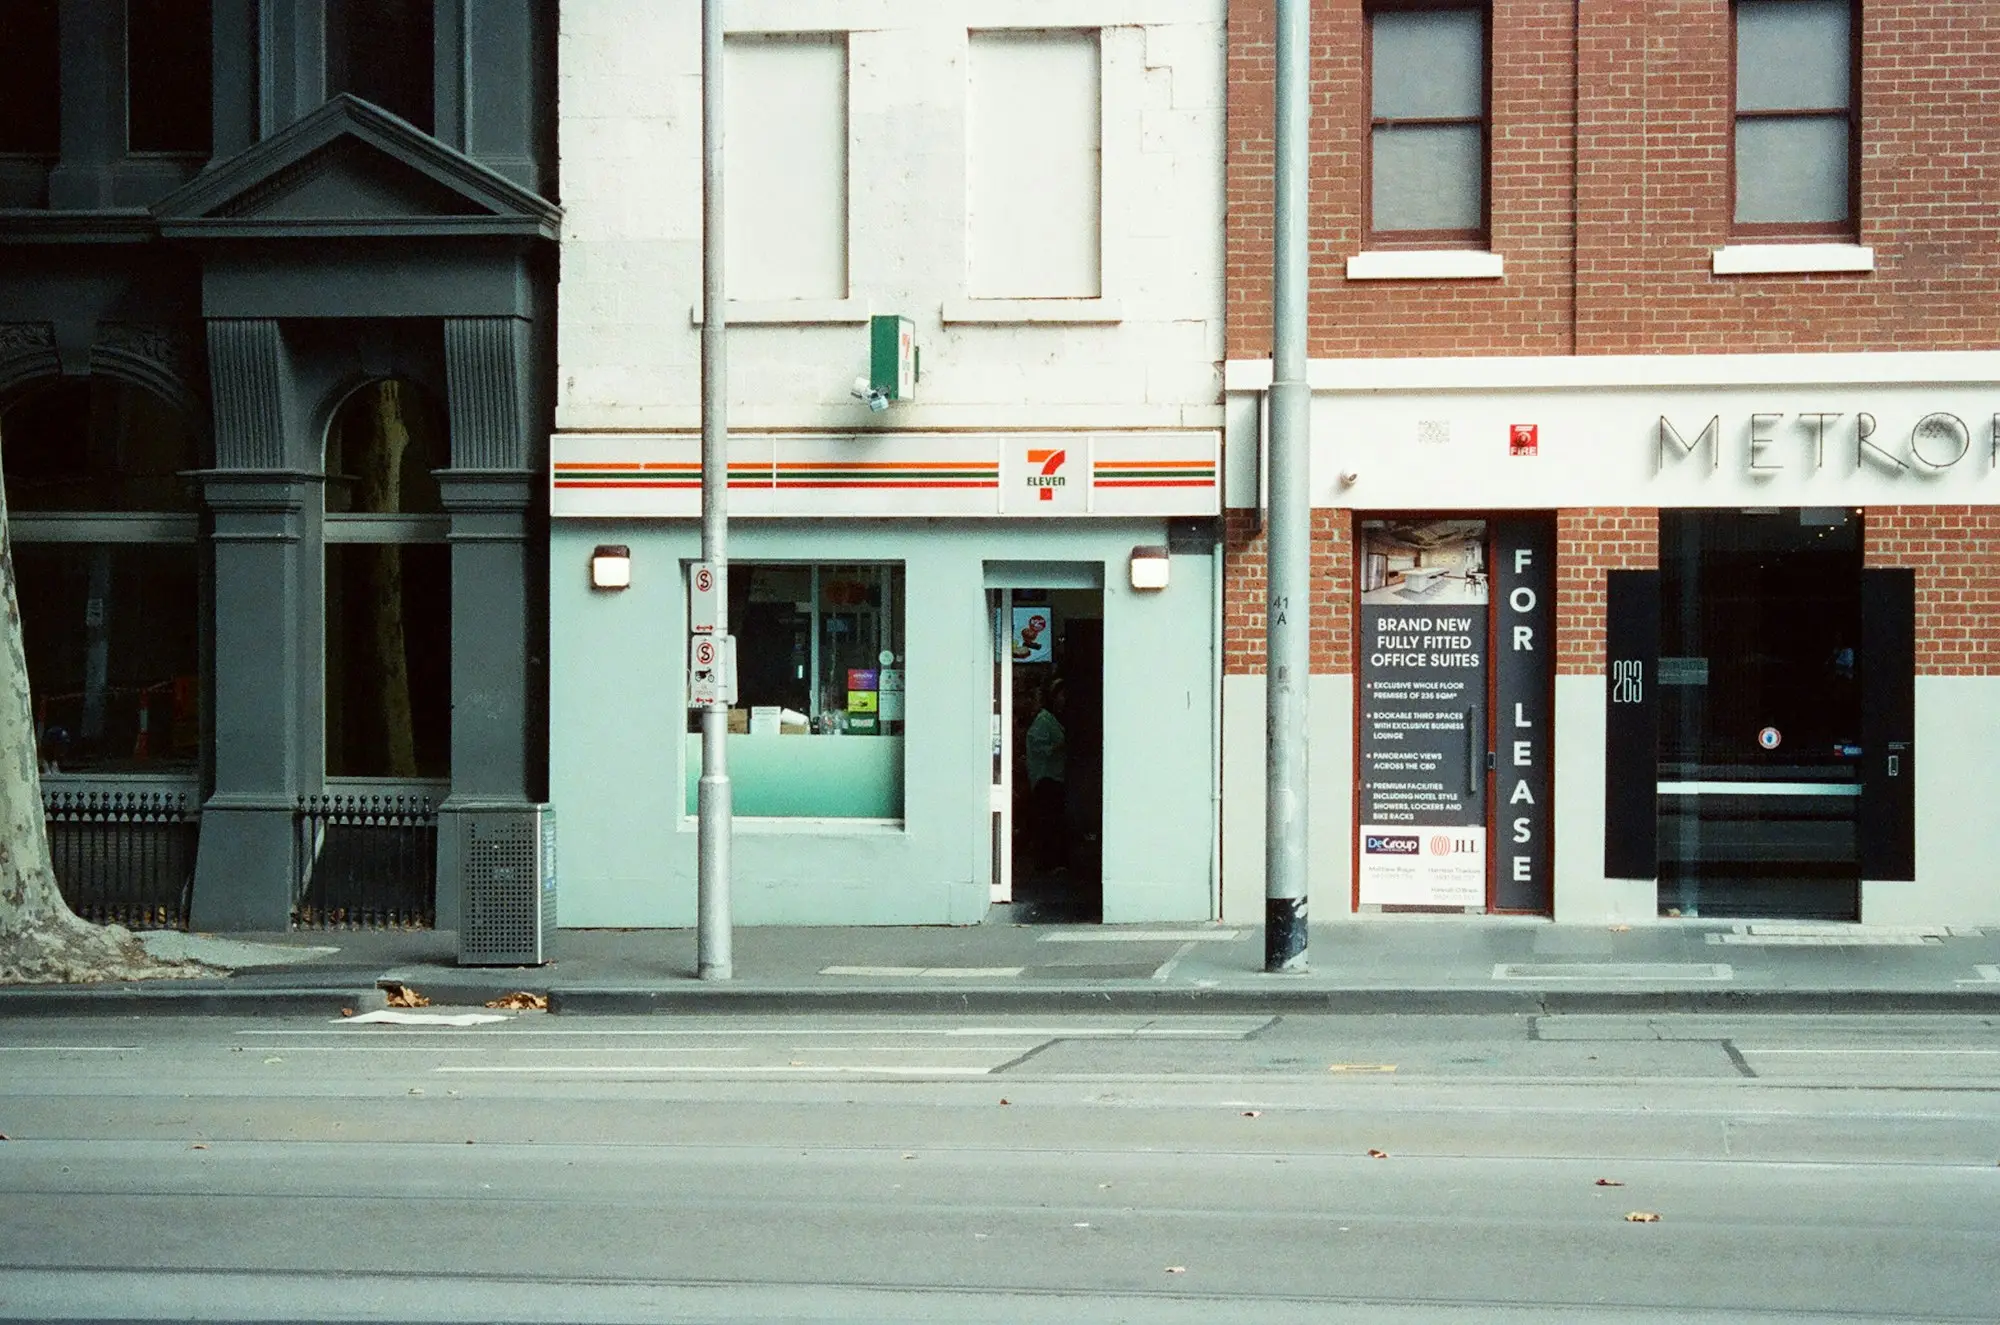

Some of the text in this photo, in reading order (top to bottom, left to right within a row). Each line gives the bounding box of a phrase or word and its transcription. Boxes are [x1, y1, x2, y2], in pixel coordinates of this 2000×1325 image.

[1510, 447, 1537, 456] FIRE
[1028, 450, 1065, 501] 7
[1378, 618, 1471, 631] BRAND NEW
[1378, 636, 1471, 649] FULLY FITTED
[1371, 653, 1479, 667] OFFICE SUITES
[1373, 681, 1465, 690] EXCLUSIVE WHOLE FLOOR
[1614, 660, 1642, 702] 263
[1408, 691, 1420, 700] OF
[1373, 711, 1464, 721] BOOKABLE THIRD SPACES
[1510, 550, 1536, 881] FOR LEASE
[1373, 722, 1465, 730] WITH EXCLUSIVE BUSINESS
[1372, 731, 1404, 740] LOUNGE
[1372, 751, 1443, 761] PANORAMIC VIEWS
[1373, 762, 1437, 771] ACROSS THE CBD
[1372, 782, 1407, 790] PREMIUM
[1437, 792, 1458, 801] STYLE
[1410, 802, 1445, 811] LOCKERS
[1372, 812, 1415, 821] BIKE RACKS
[1368, 838, 1417, 851] DeGroup
